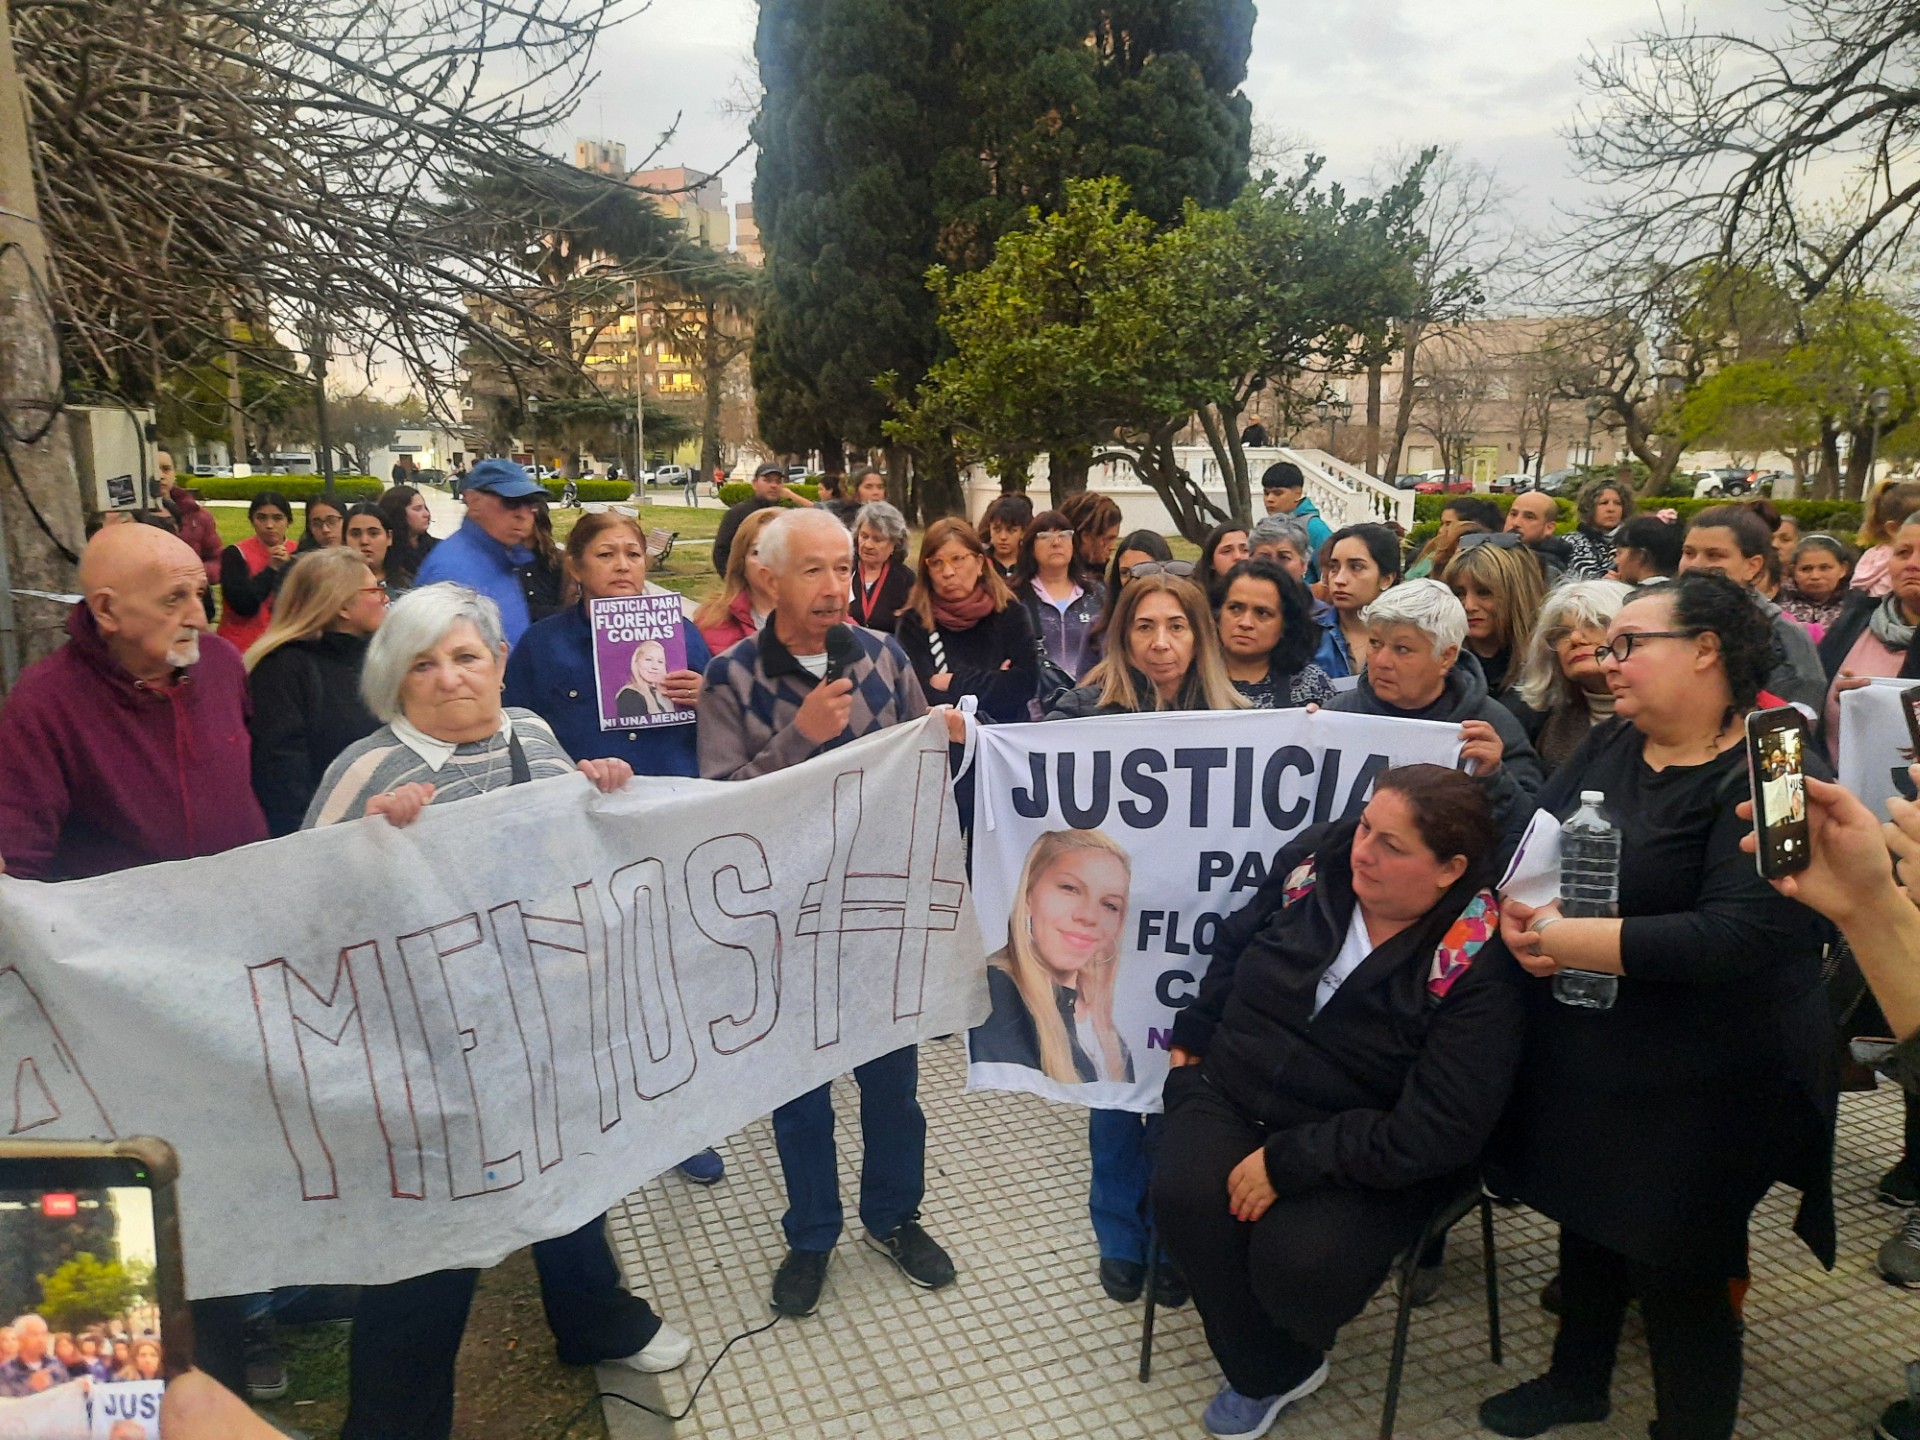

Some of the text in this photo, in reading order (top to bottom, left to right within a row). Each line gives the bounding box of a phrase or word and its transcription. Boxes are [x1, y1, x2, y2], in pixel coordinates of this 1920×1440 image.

[595, 596, 680, 614] JUSTICIA PARA
[595, 609, 681, 630] FLORENCIA
[607, 625, 674, 642] COMAS
[602, 710, 696, 727] NI UNA MENOS
[1197, 851, 1267, 892] PA
[1137, 910, 1224, 956] FLO
[1155, 969, 1197, 1009] C
[1147, 1027, 1173, 1051] N
